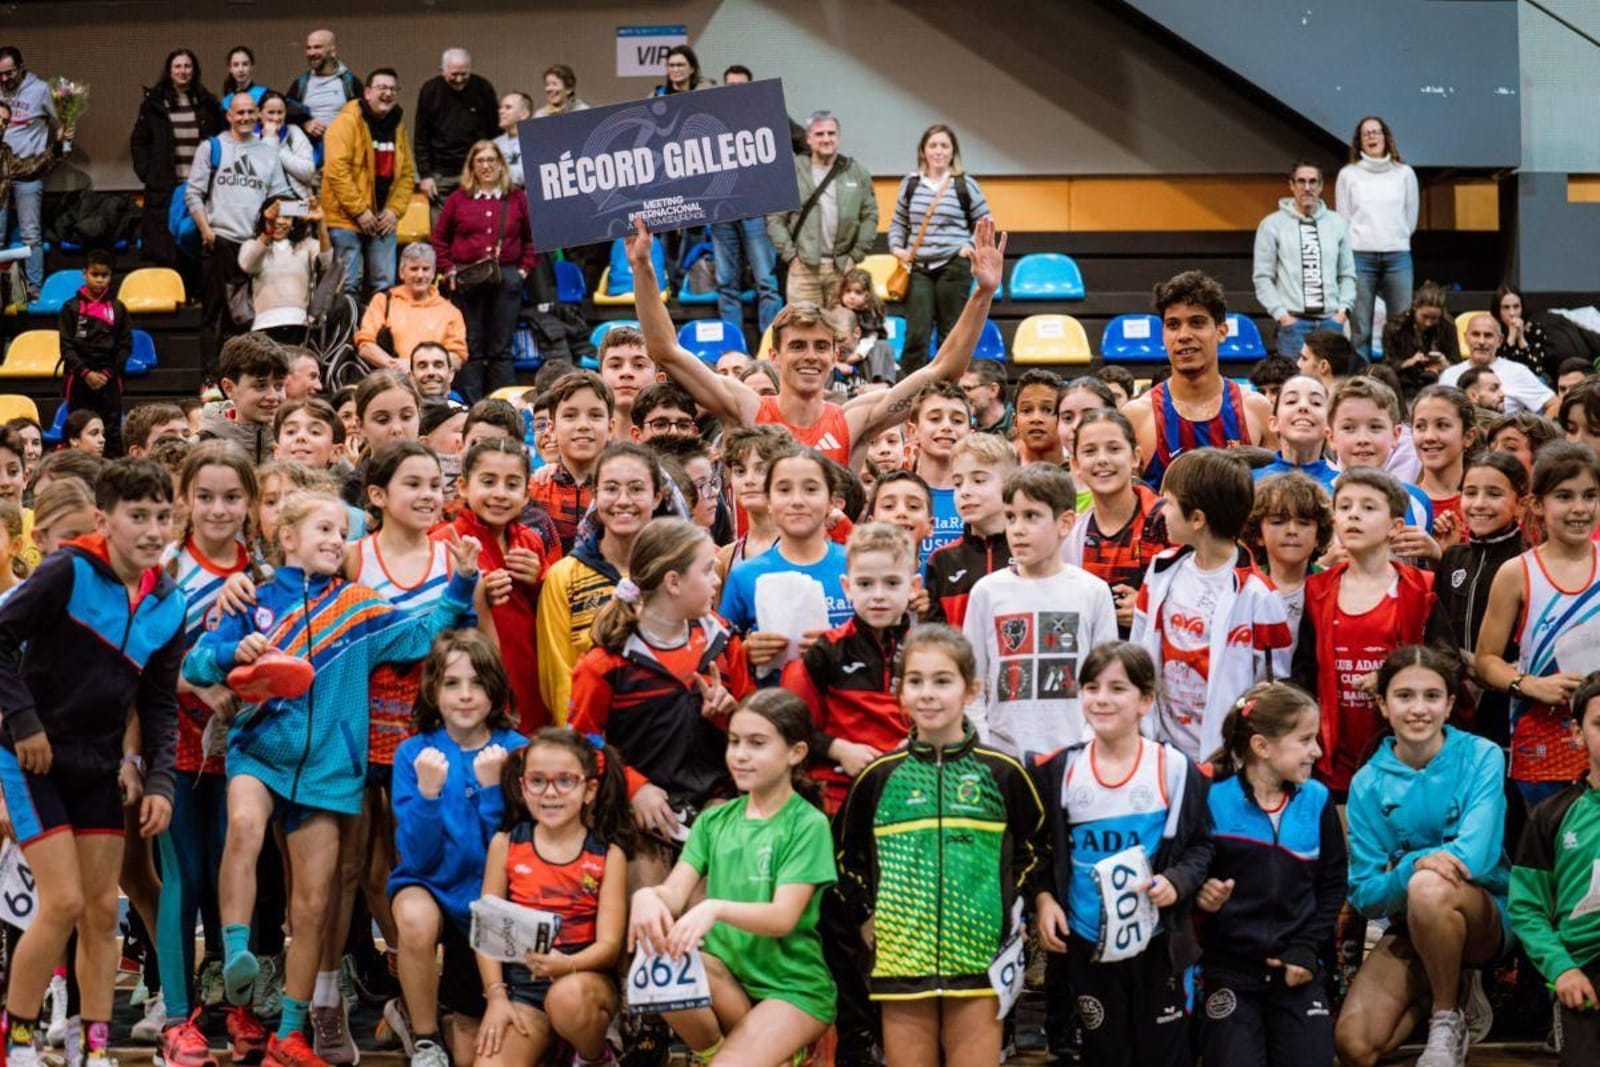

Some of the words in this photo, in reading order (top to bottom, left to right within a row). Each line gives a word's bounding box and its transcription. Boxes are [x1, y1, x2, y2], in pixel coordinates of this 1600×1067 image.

[637, 45, 670, 66] VIP
[539, 150, 656, 200] RÉCORD
[663, 127, 777, 180] GALEGO
[217, 175, 264, 190] adidas
[628, 202, 702, 222] INTERNACIONAL
[643, 196, 684, 210] MEETING
[1111, 863, 1142, 950] 605
[633, 951, 697, 989] 662
